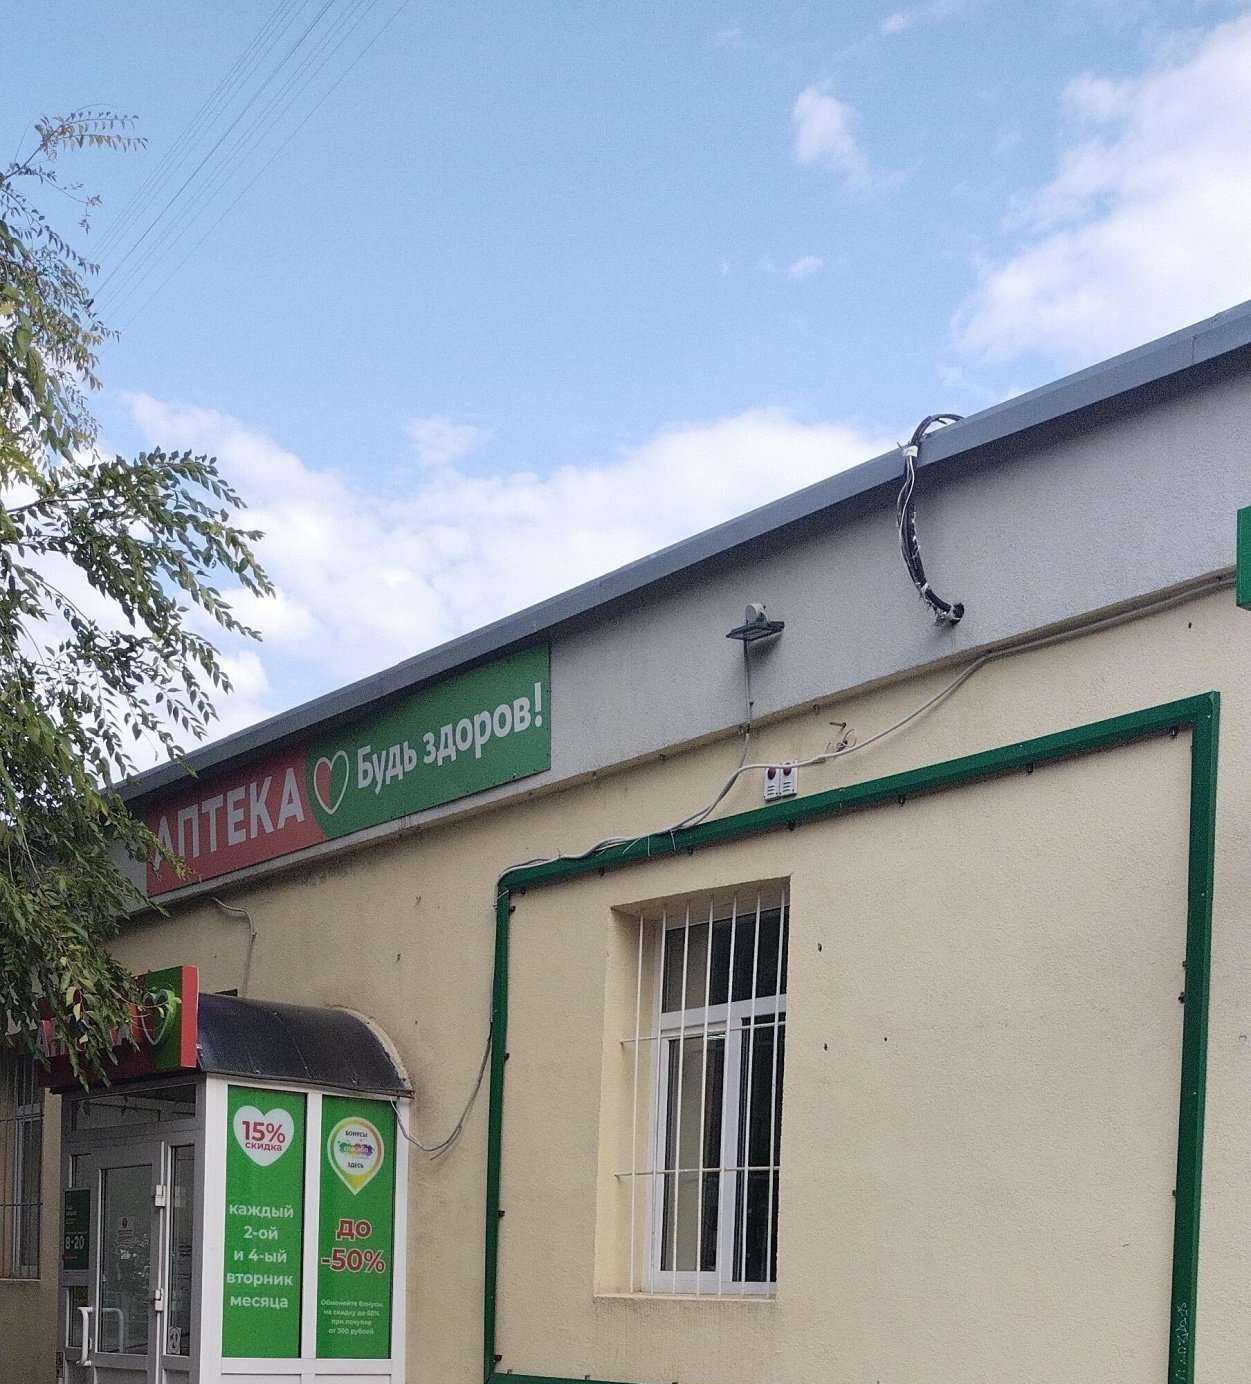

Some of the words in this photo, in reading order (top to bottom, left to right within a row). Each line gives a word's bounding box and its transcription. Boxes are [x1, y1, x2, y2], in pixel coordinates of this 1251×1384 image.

[357, 745, 417, 795] Будь
[423, 682, 543, 760] здоров!
[153, 767, 305, 871] АПТЕКА
[242, 1120, 286, 1143] 15%
[245, 1142, 282, 1152] скидка
[229, 1204, 294, 1219] каждый
[243, 1225, 279, 1240] 2-ой
[233, 1250, 244, 1261] и
[248, 1248, 288, 1263] 4-ый
[320, 1247, 386, 1274] -50%
[226, 1272, 294, 1287] вторник
[230, 1295, 289, 1310] месяца
